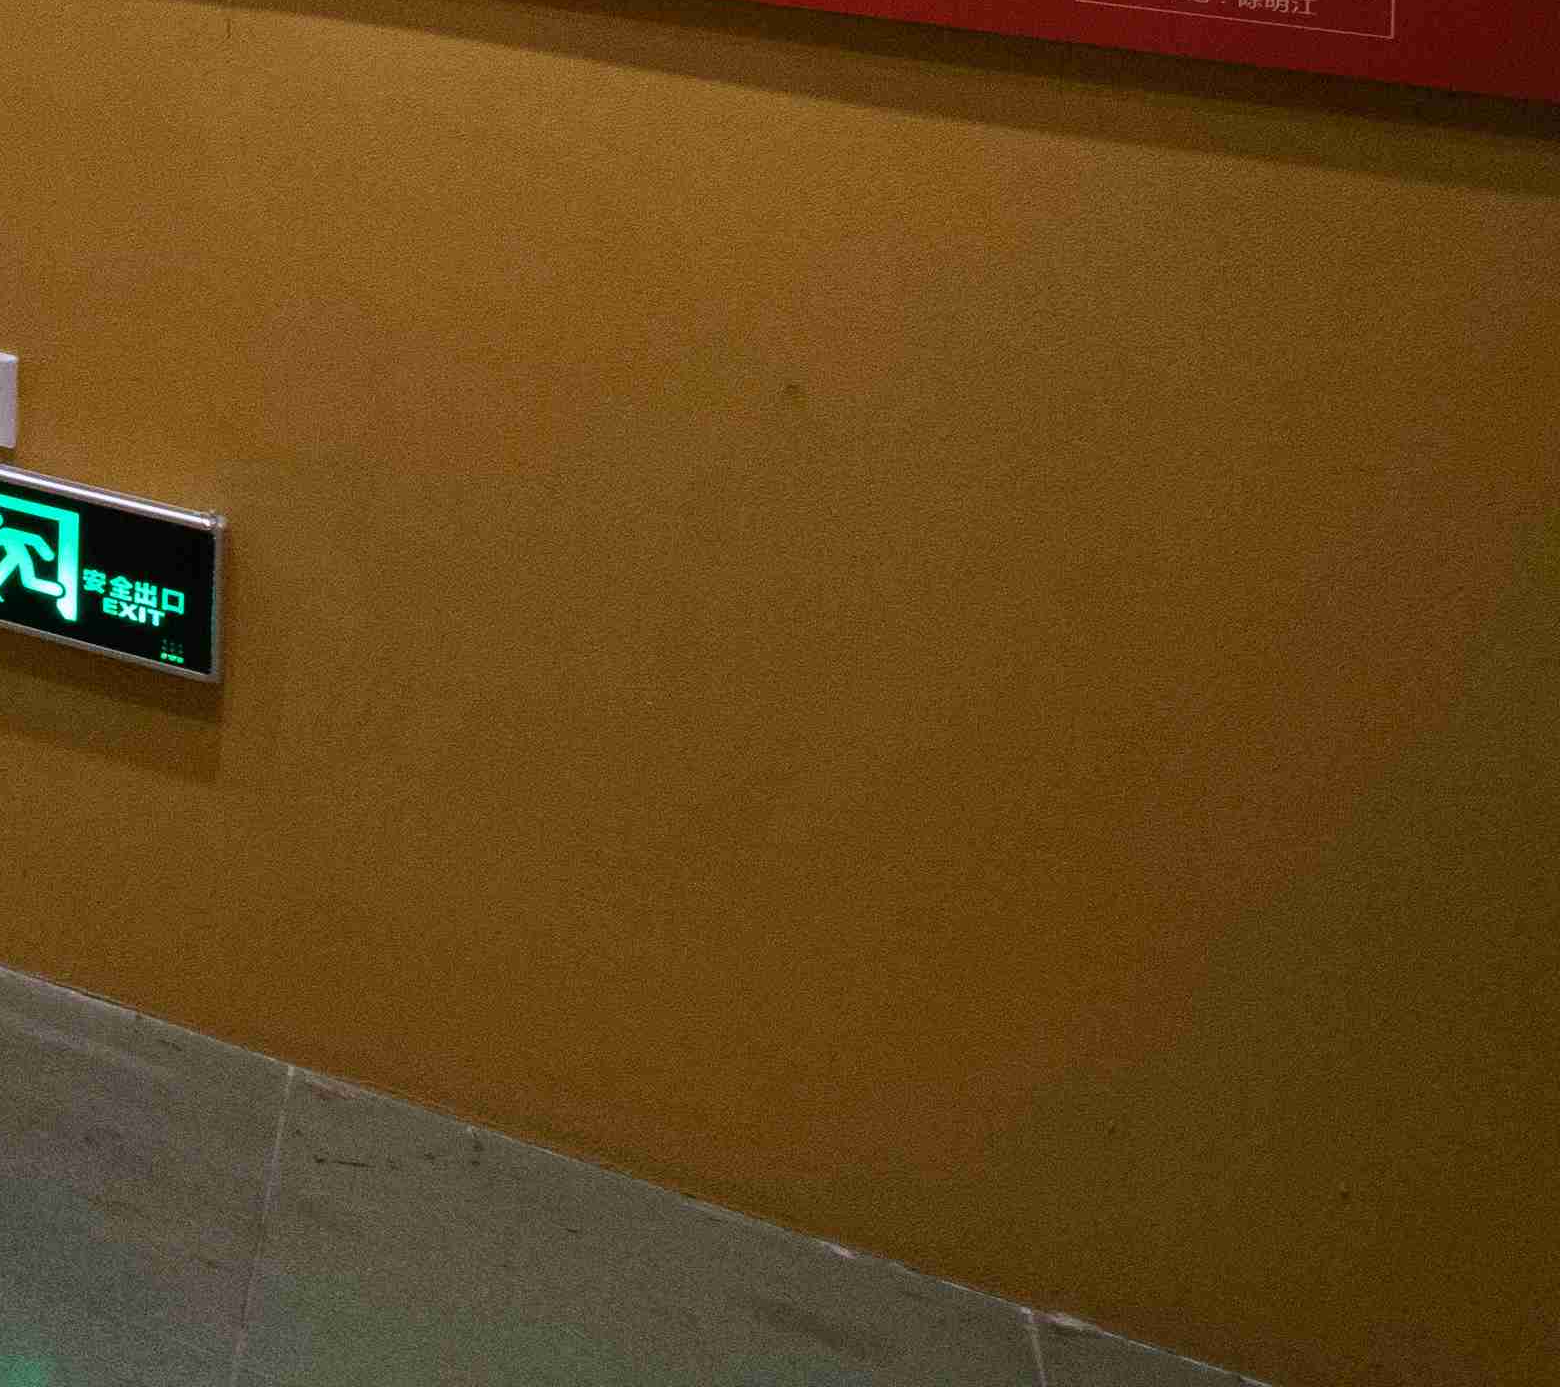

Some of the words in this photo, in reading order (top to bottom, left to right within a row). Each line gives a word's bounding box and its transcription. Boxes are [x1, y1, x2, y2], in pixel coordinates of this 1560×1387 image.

[82, 569, 185, 615] 安全出口
[102, 599, 165, 626] EXIT
